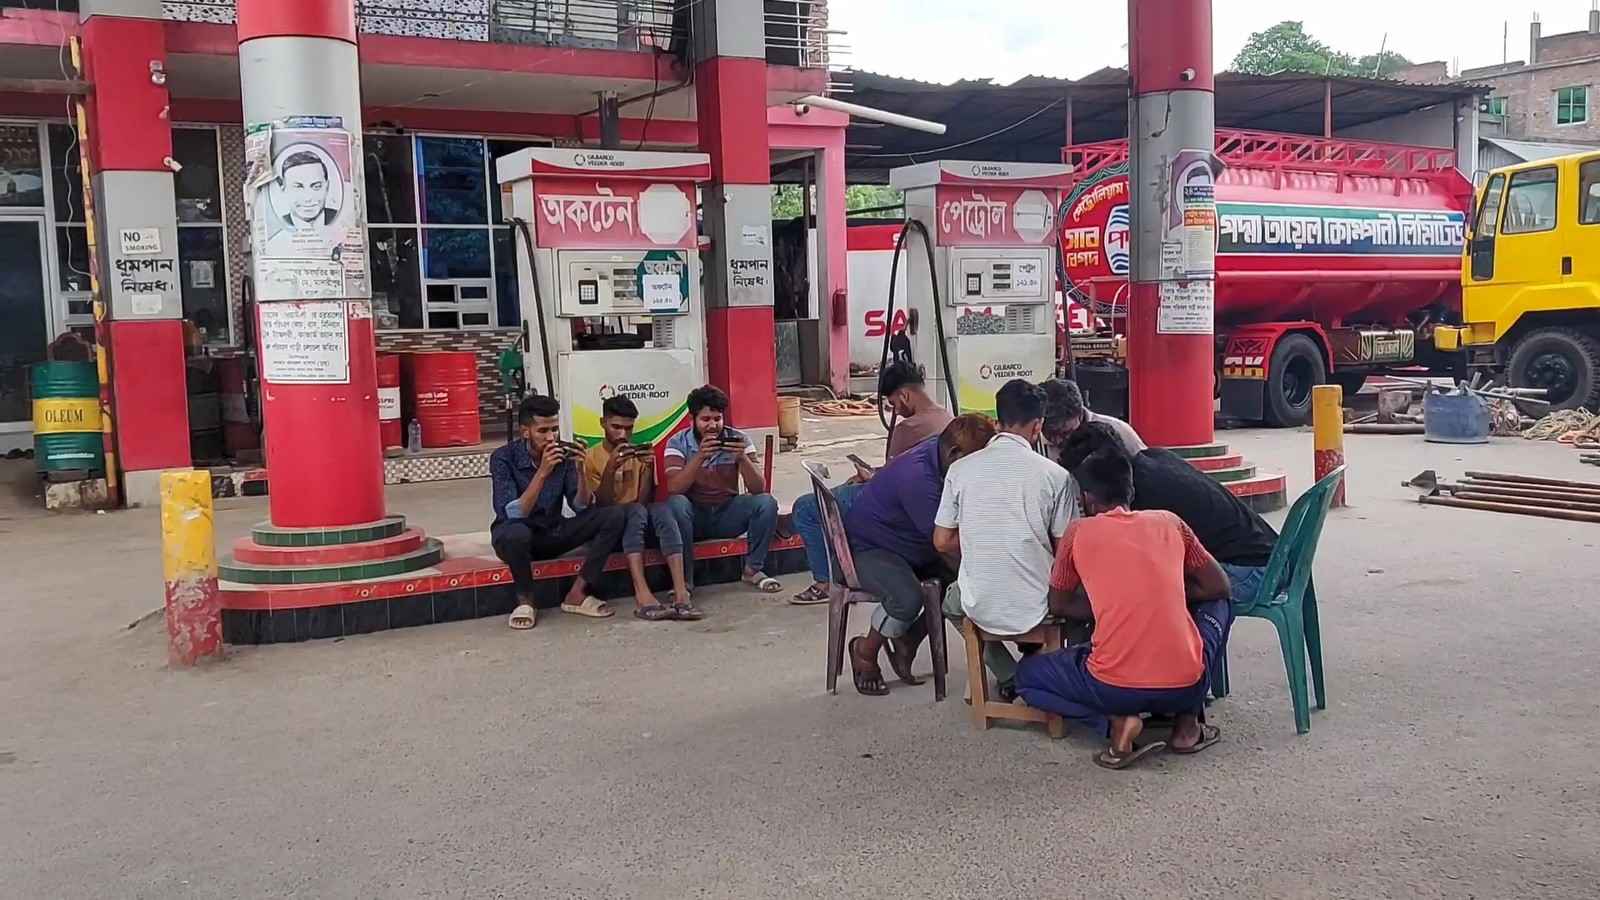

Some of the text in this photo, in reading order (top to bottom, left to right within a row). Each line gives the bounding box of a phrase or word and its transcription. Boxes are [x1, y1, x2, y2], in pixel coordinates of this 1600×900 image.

[538, 182, 635, 236] অকটেন
[942, 190, 1008, 239] পেট্রোল
[124, 232, 141, 242] NO
[1219, 214, 1262, 246] পদ্মা
[617, 384, 655, 392] GILBARCO
[45, 409, 83, 423] OLEUM
